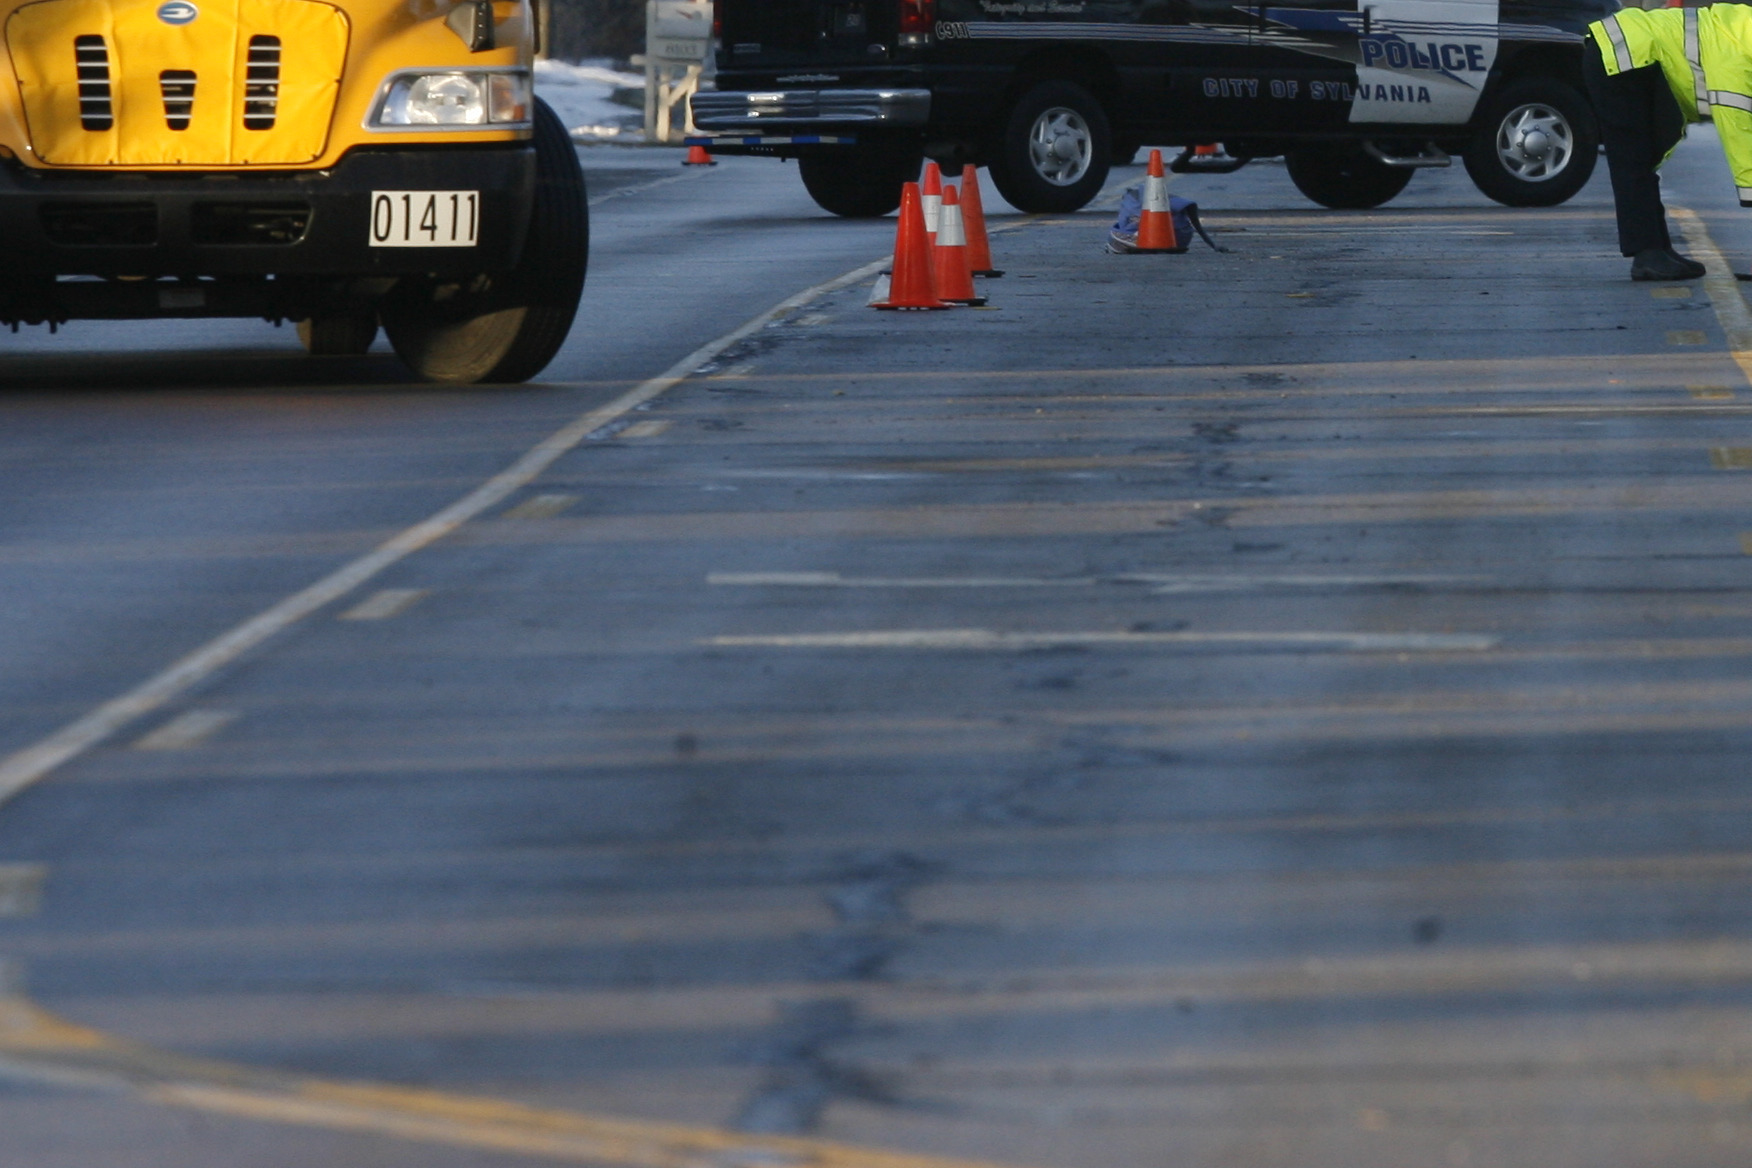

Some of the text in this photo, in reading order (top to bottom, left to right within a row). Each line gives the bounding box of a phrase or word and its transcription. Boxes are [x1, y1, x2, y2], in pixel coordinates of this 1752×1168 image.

[1358, 38, 1488, 71] POLICE
[1202, 77, 1432, 103] CITY OF SYLVANIA
[373, 193, 476, 242] 01411
